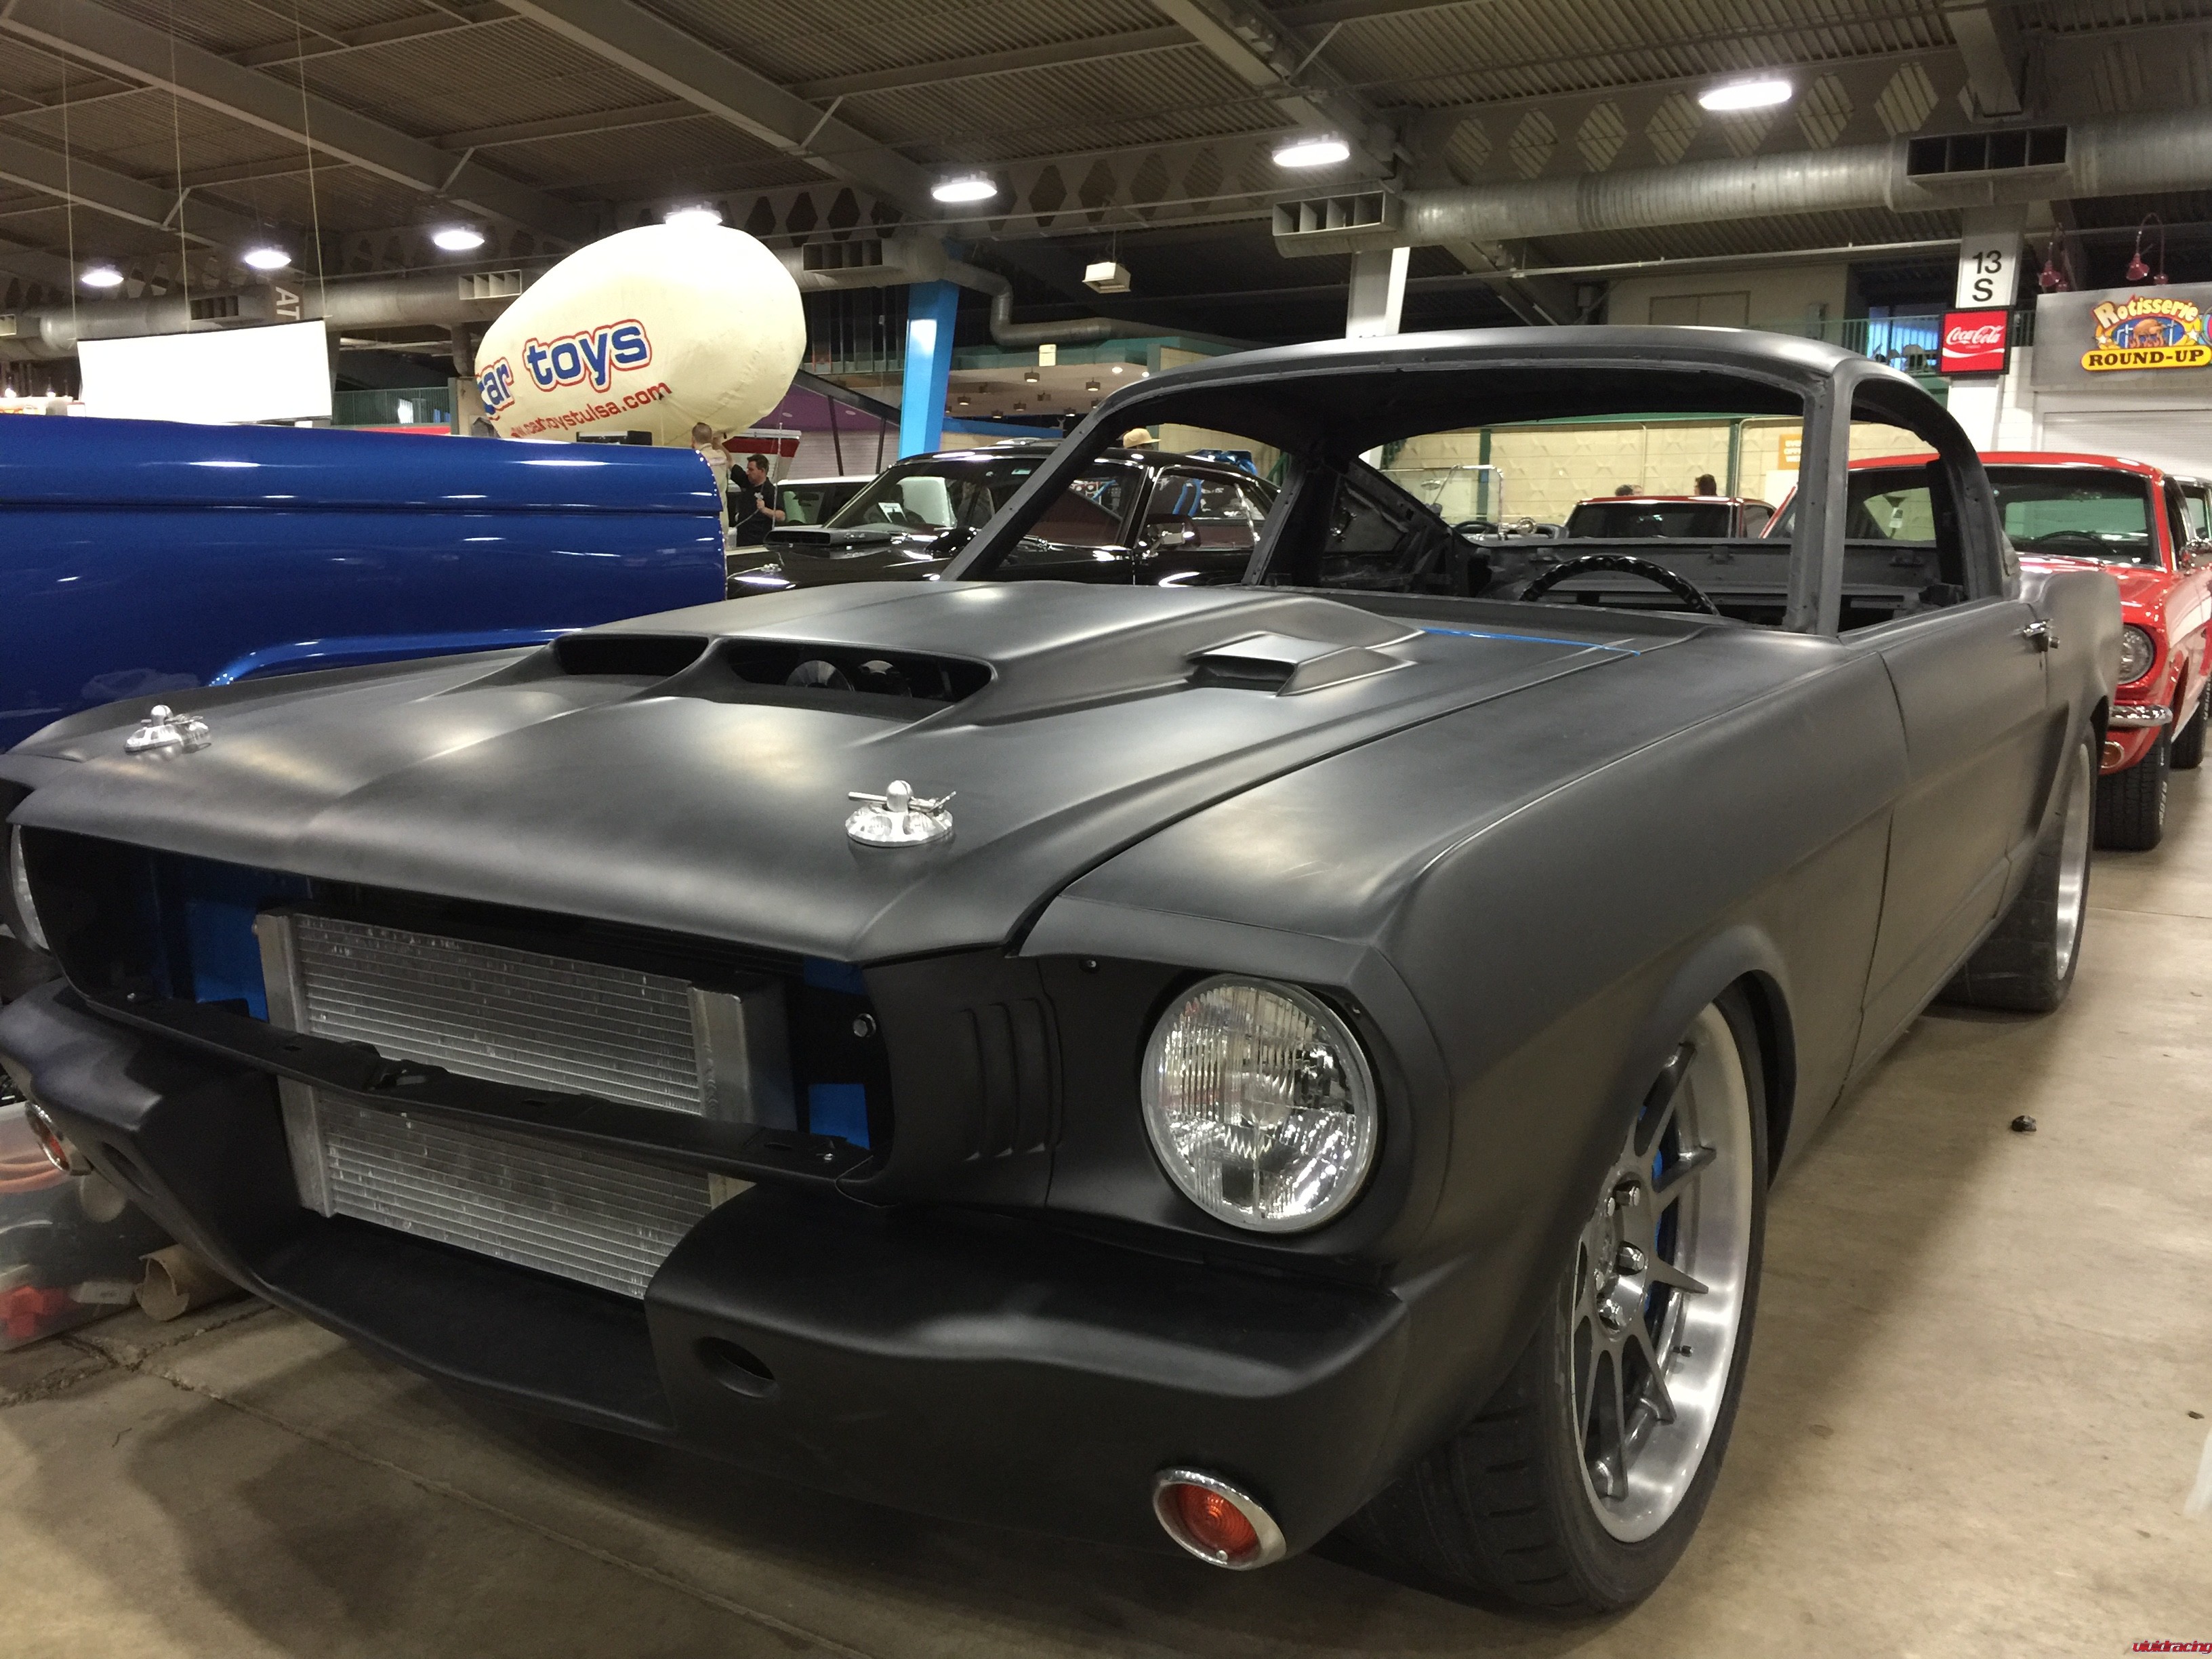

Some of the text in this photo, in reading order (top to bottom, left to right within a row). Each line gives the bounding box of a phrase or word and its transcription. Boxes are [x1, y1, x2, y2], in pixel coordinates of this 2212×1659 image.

[1972, 249, 2002, 274] 13
[1971, 277, 1994, 302] S
[2093, 297, 2198, 329] Rotisserie
[1946, 325, 2005, 346] Coca-Cola
[525, 322, 651, 390] toys
[2088, 348, 2205, 367] ROUND-UP
